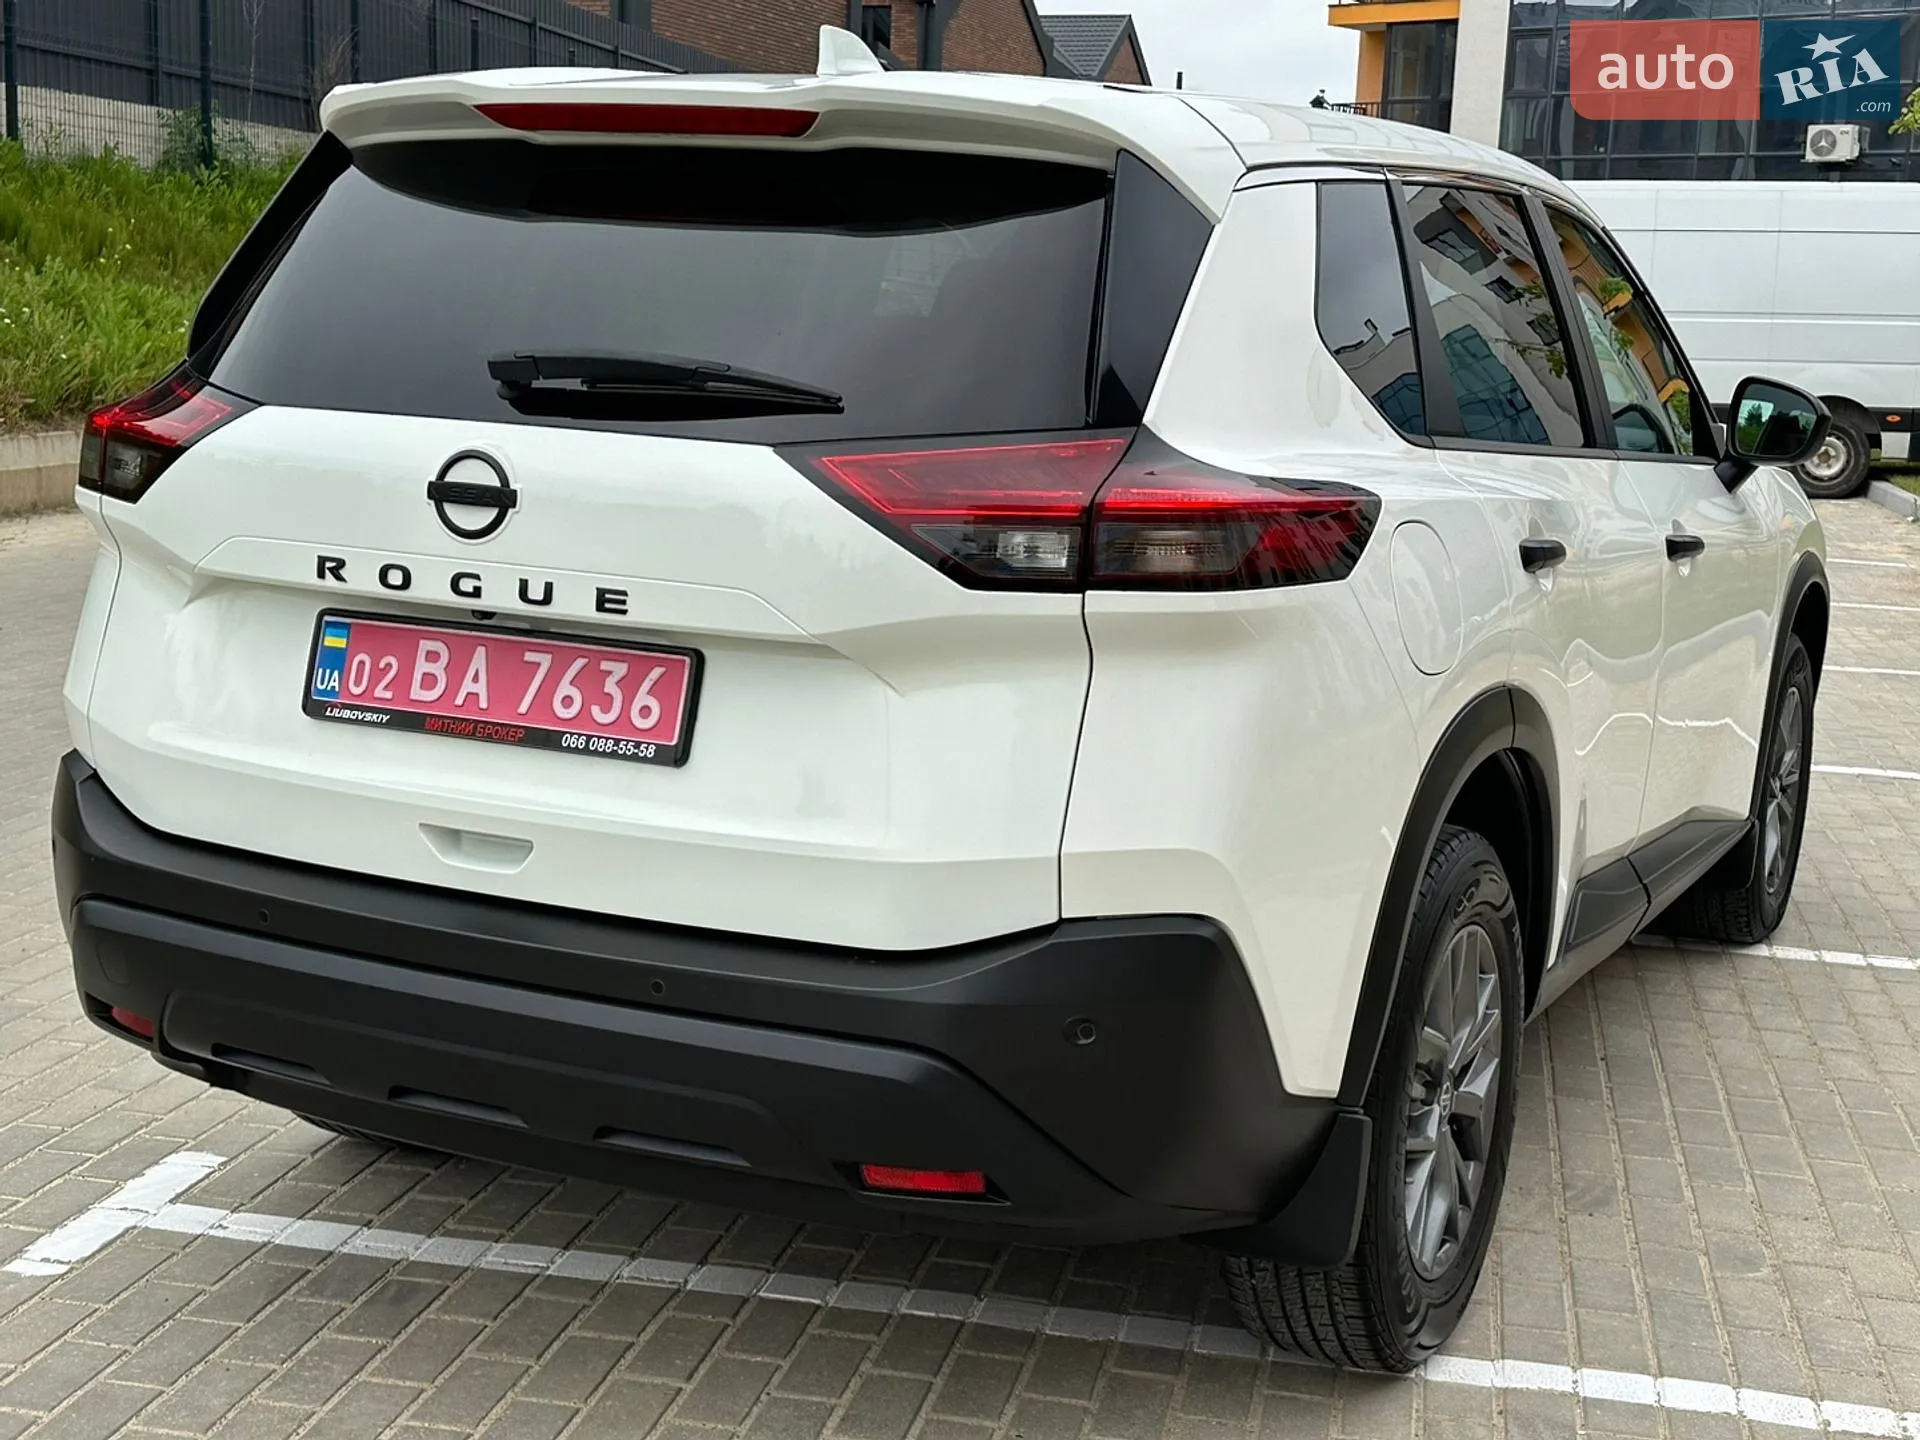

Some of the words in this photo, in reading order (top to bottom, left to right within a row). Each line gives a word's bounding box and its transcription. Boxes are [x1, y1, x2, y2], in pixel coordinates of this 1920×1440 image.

[431, 482, 516, 508] NSSAN
[316, 555, 629, 615] ROGUE
[316, 668, 340, 691] UA
[347, 652, 399, 700] 02
[409, 638, 489, 710] BA
[517, 652, 666, 731] 7636
[424, 716, 473, 735] МИТНИЙ
[476, 724, 525, 742] БРОКЕР
[561, 733, 586, 749] 066
[589, 736, 656, 758] 088-55-58
